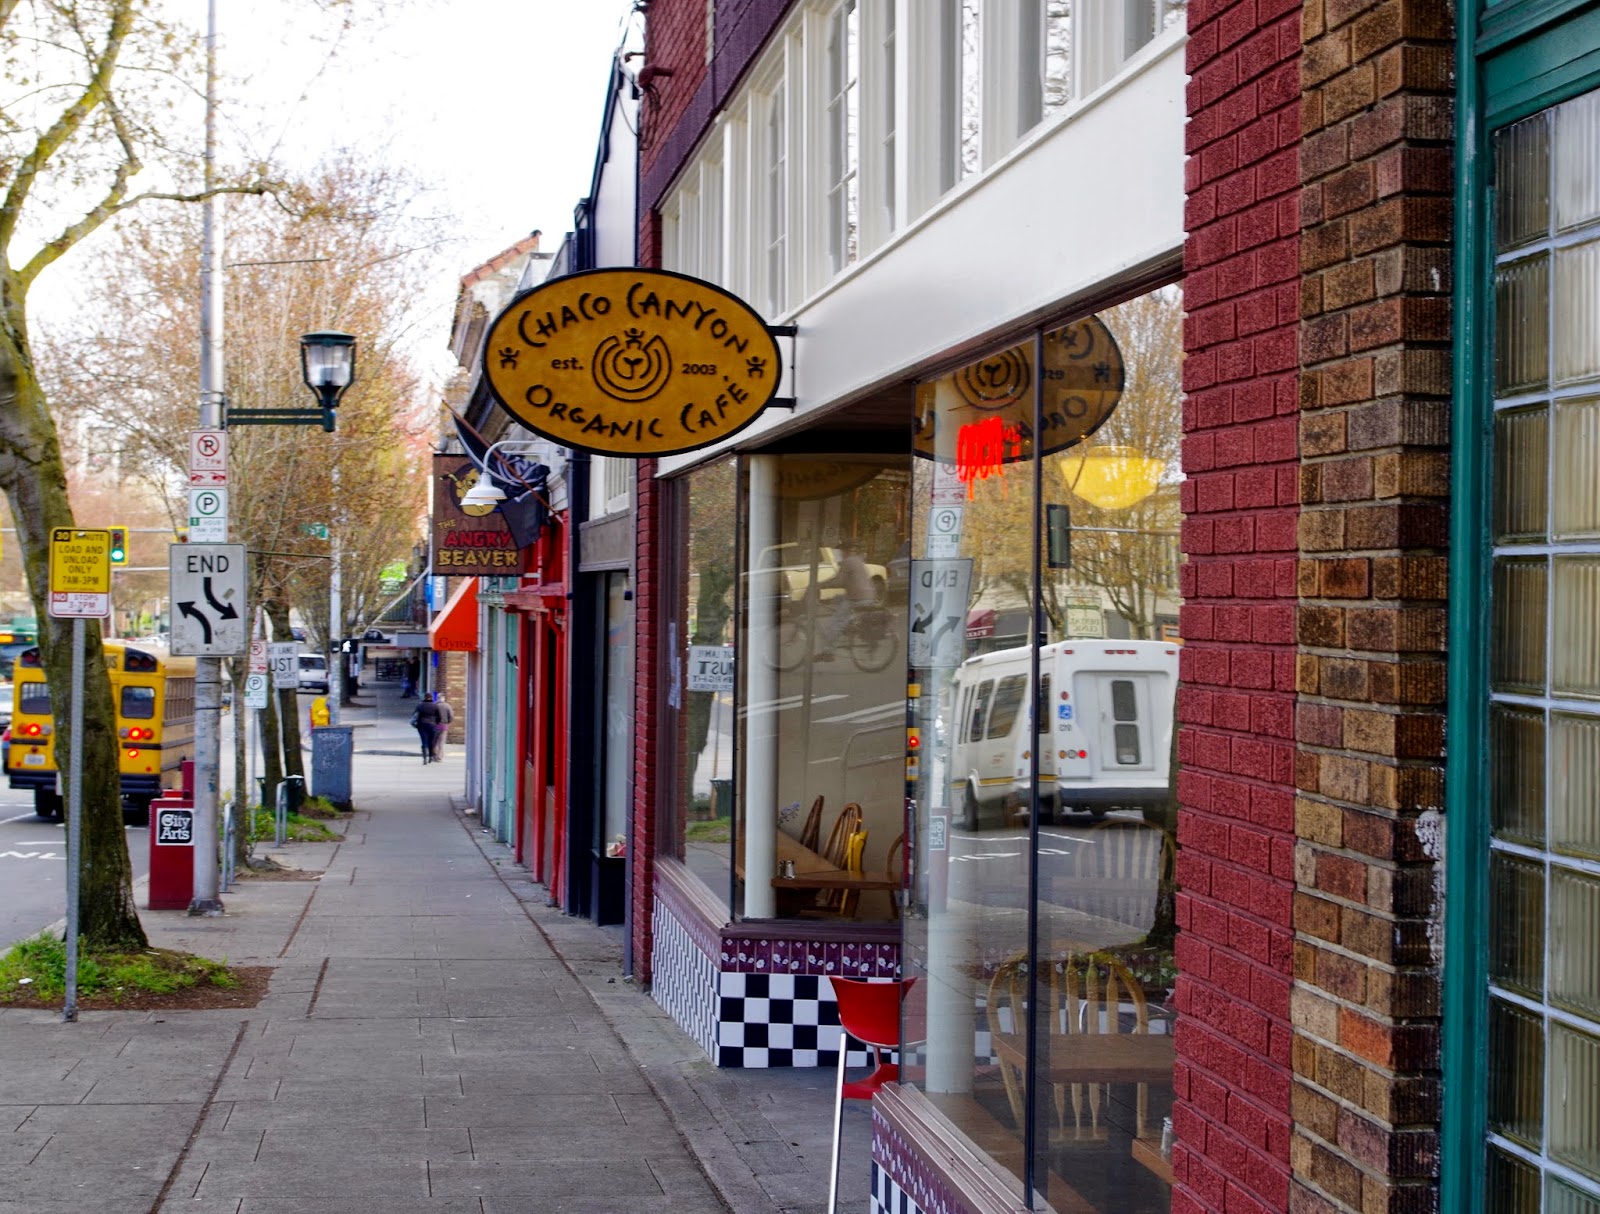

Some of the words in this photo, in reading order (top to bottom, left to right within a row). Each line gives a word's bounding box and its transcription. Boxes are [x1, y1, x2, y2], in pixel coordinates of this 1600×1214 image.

[518, 293, 610, 347] CHACO
[627, 282, 749, 353] CANYON
[551, 357, 584, 370] est.
[682, 364, 716, 375] 2003
[525, 385, 664, 441] ORGANIC
[437, 519, 457, 530] THE
[55, 532, 70, 540] 30
[444, 530, 512, 547] ANGRY
[58, 545, 82, 554] LOAD
[86, 545, 104, 554] AND
[63, 556, 99, 564] UNLOAD
[187, 555, 230, 573] END
[438, 549, 518, 566] BEAVER
[68, 565, 92, 574] ONLY
[62, 575, 99, 585] 7AM-3PM
[439, 637, 474, 650] Gyros
[270, 657, 293, 671] UST
[161, 814, 191, 829] City
[160, 827, 190, 840] Arts
